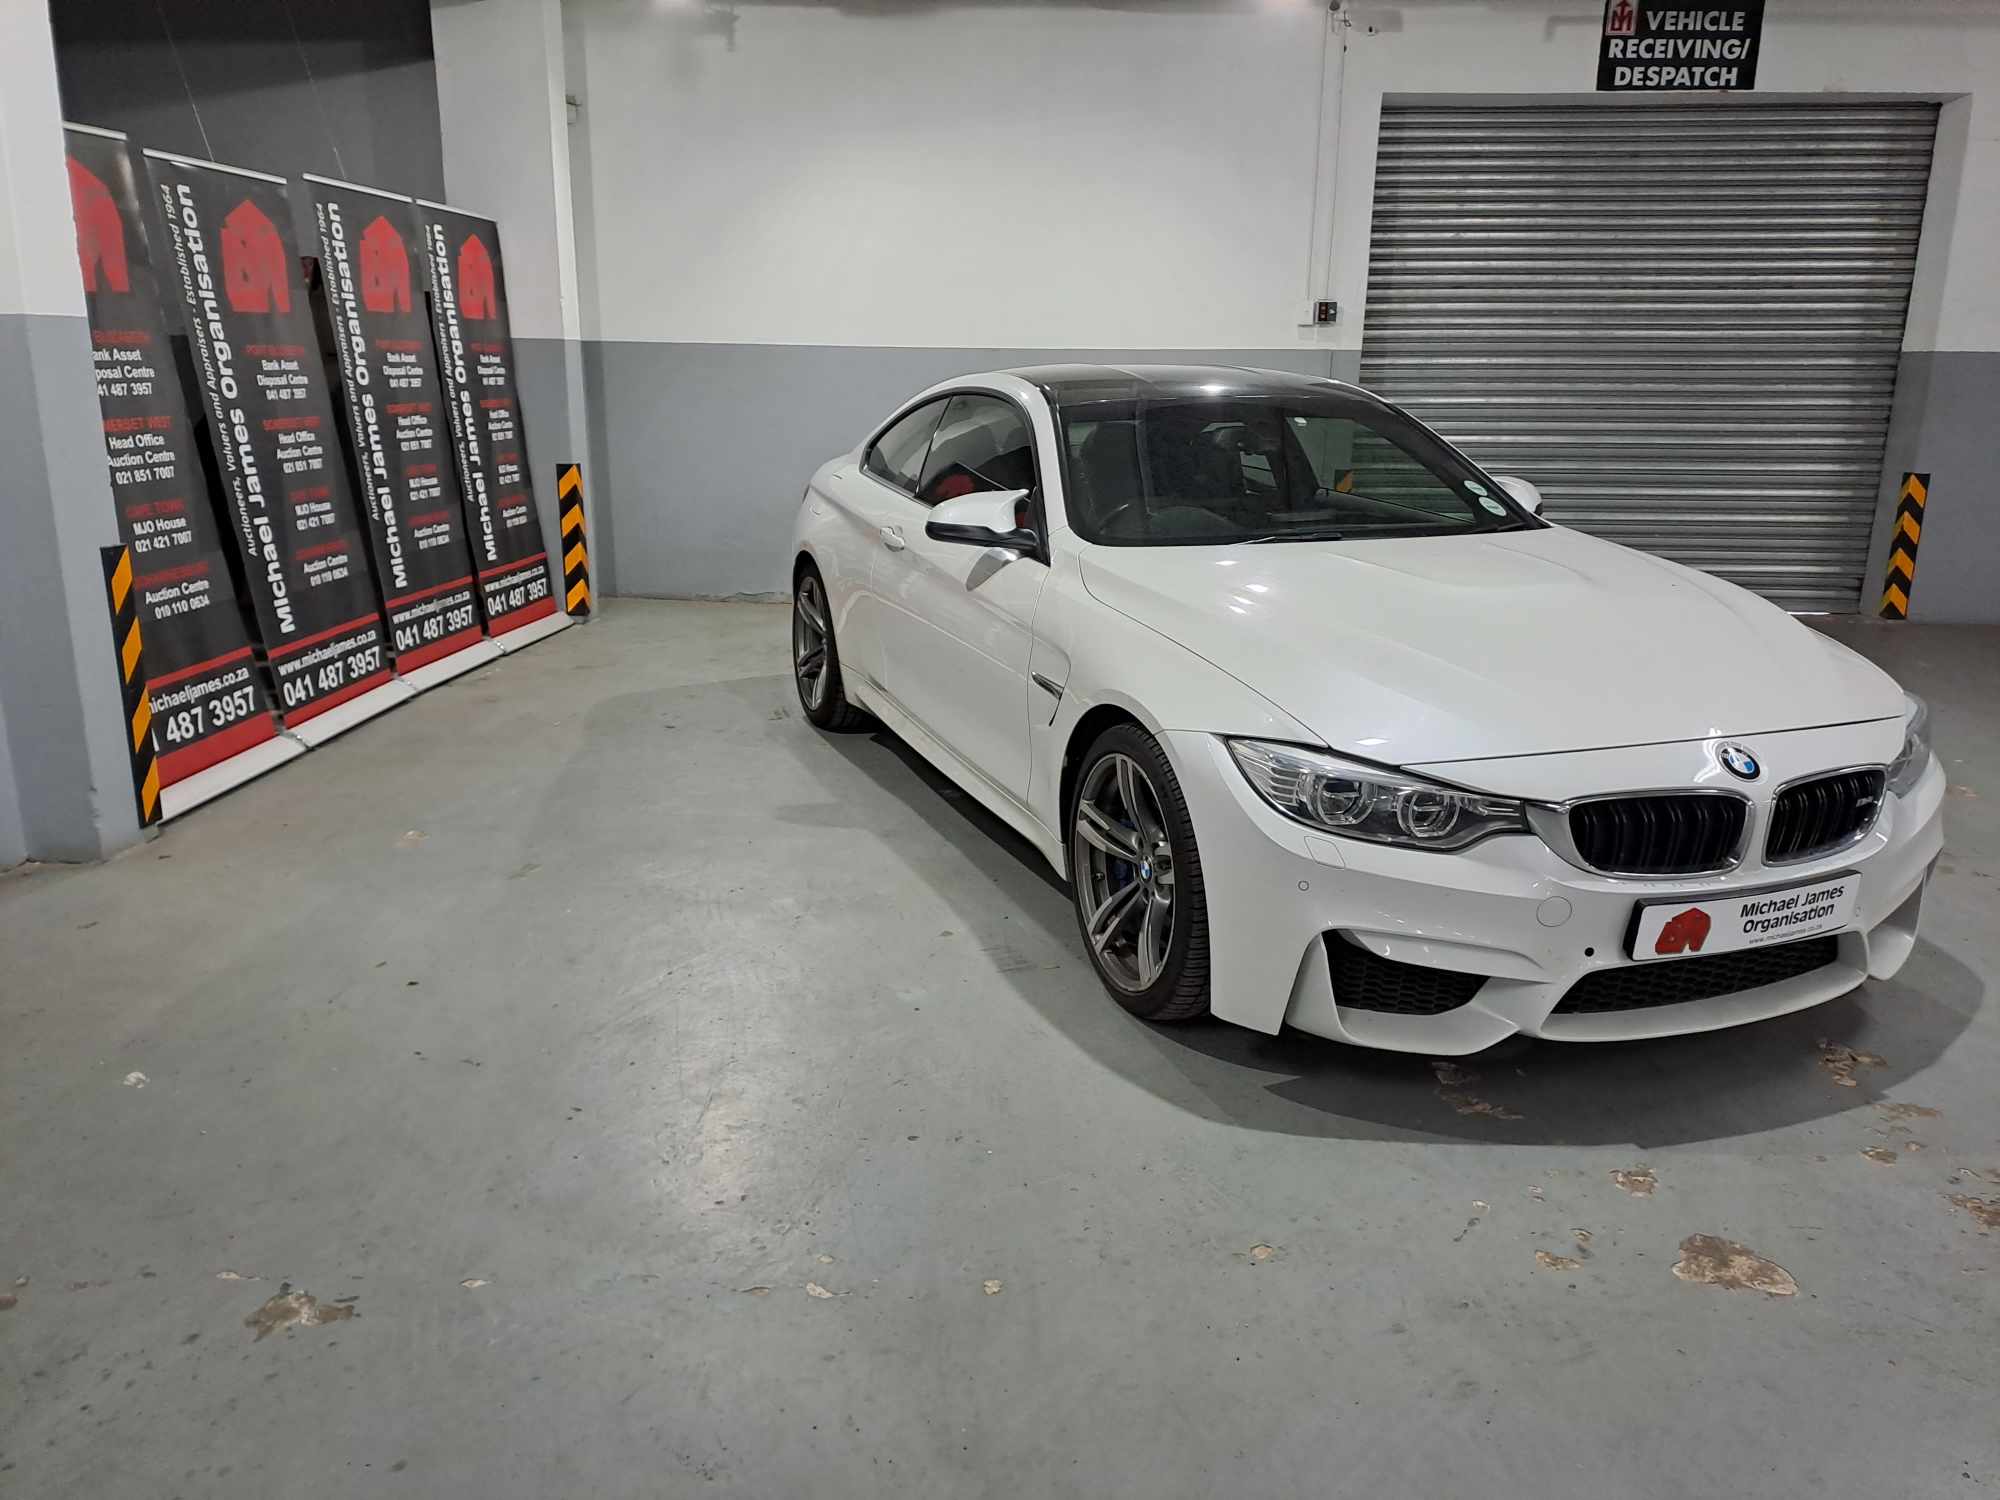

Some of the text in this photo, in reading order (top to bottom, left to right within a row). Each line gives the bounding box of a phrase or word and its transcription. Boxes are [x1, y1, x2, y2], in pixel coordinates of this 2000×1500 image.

[1646, 10, 1746, 31] VEHICLE
[1607, 38, 1751, 60] RECEIVING/
[1613, 66, 1739, 87] DESPATCH
[160, 184, 176, 220] 1964
[169, 223, 196, 304] Established
[92, 348, 142, 361] ank Asset
[192, 317, 217, 390] Appraisers
[95, 365, 155, 381] posal Centre
[97, 383, 109, 396] 41
[110, 383, 127, 396] 487
[209, 391, 224, 419] and
[328, 203, 408, 588] Michael James Organisation
[433, 224, 497, 561] Michael James Organisation
[177, 184, 295, 633] Michael James Organisation
[108, 433, 165, 449] Head Office
[144, 450, 175, 463] Centre
[218, 422, 236, 471] Valuers
[115, 470, 133, 485] 021
[134, 468, 152, 482] 851
[155, 517, 187, 532] House
[135, 538, 152, 553] 021
[153, 535, 170, 549] 421
[145, 587, 181, 605] Auction
[487, 578, 548, 616] 041 487 3957
[395, 604, 473, 651] 041 487 3957
[149, 667, 250, 714] ichaeljames.co.za
[283, 646, 380, 706] 041 487 3957
[166, 706, 204, 743] 487
[208, 685, 255, 727] 3957
[1740, 885, 1845, 918] Michael James
[1742, 903, 1835, 934] Organisation
